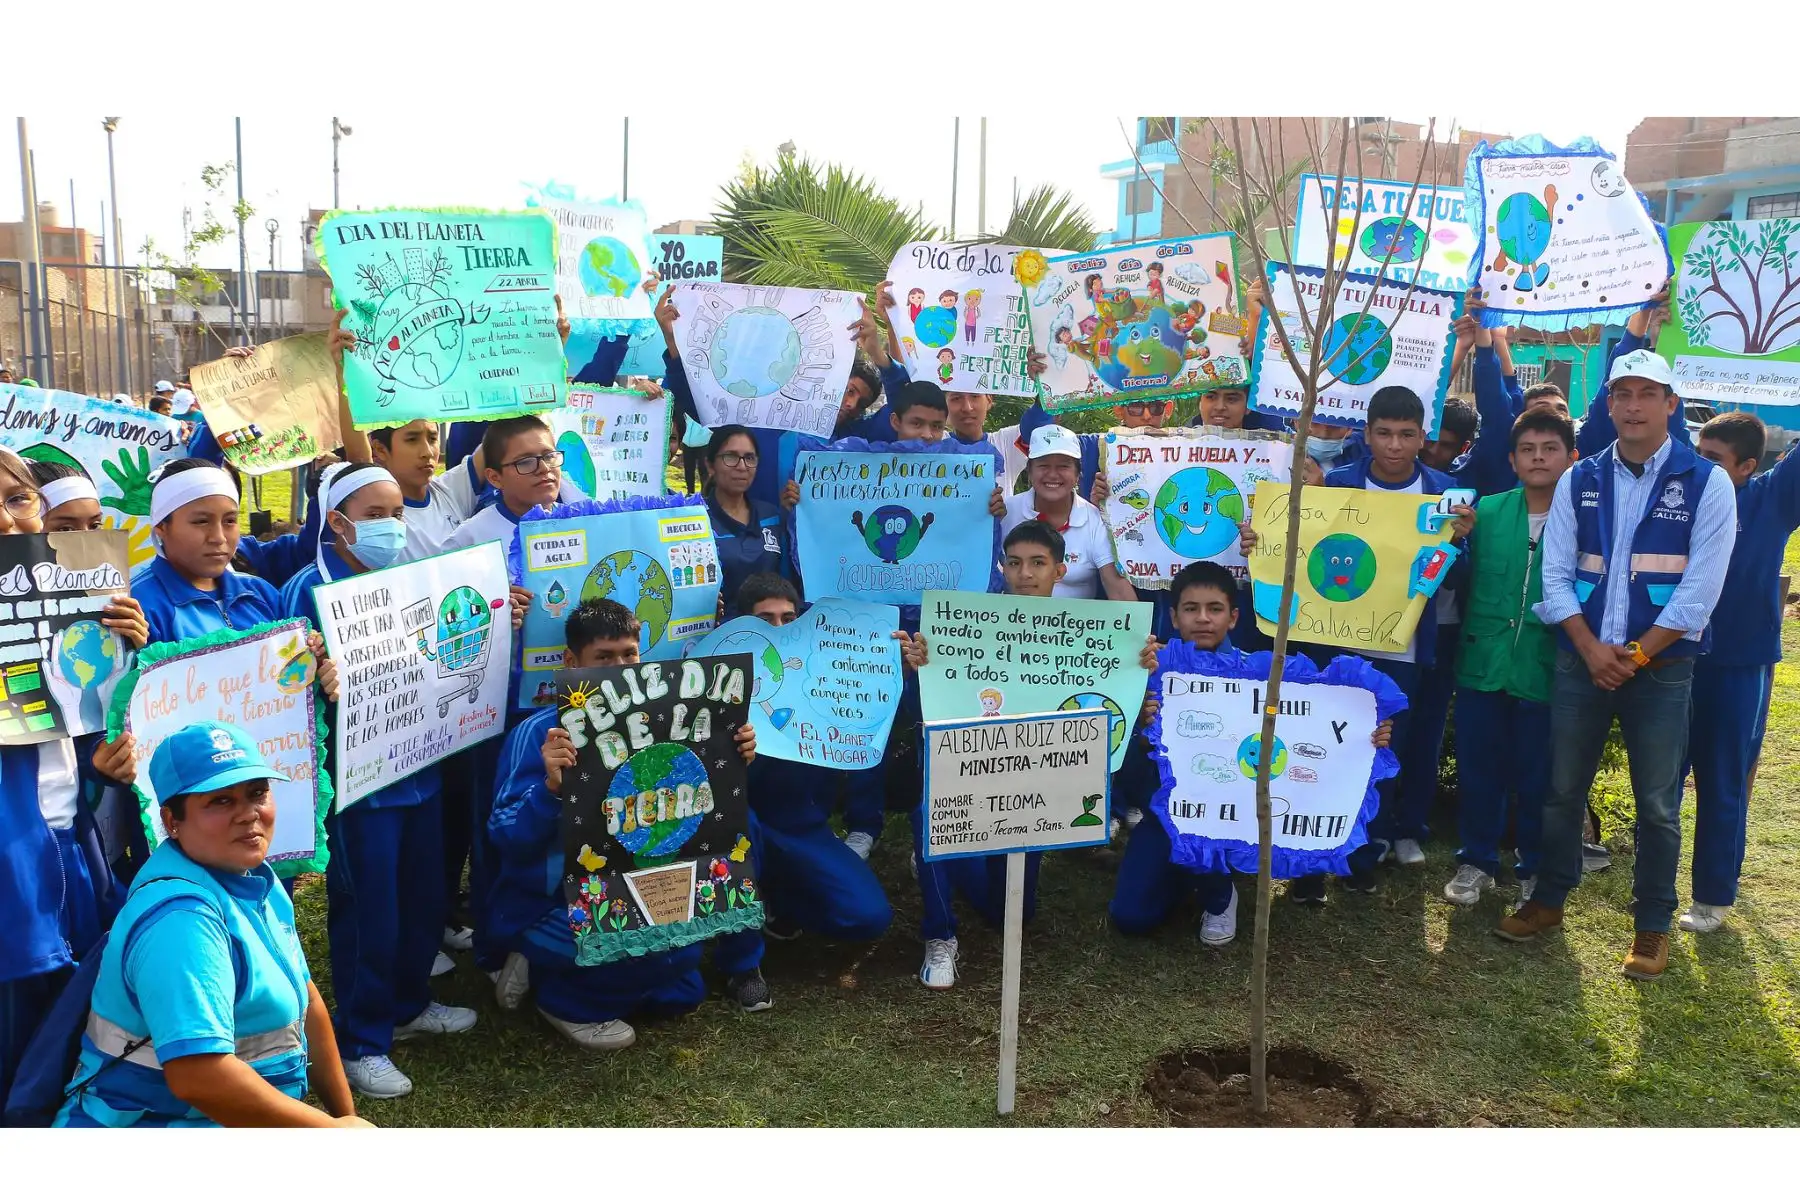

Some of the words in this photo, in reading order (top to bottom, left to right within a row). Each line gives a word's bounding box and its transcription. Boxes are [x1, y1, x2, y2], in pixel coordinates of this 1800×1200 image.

[1382, 191, 1412, 215] TU
[336, 224, 376, 245] DIA
[378, 222, 413, 240] DEL
[418, 222, 485, 241] PLANETA
[456, 245, 532, 271] TIERRA
[661, 240, 685, 262] YO
[912, 245, 952, 269] Día
[956, 247, 975, 272] de
[977, 248, 1004, 276] La
[1156, 247, 1174, 258] de
[1177, 244, 1193, 255] la
[658, 260, 718, 281] HOGAR
[498, 278, 513, 287] 22
[515, 277, 540, 286] ABRIL
[742, 285, 785, 309] TU
[1343, 287, 1366, 304] TU
[1372, 292, 1442, 316] HUELLA
[401, 330, 414, 342] AL
[412, 304, 454, 331] PLANETA
[378, 351, 391, 368] YO
[976, 374, 989, 389] A
[991, 374, 1009, 390] LA
[1734, 372, 1749, 380] nos
[1273, 388, 1283, 399] Y
[1328, 397, 1344, 409] EL
[64, 414, 83, 441] y
[85, 417, 180, 450] amemos
[1116, 444, 1153, 465] DEJA
[1161, 447, 1181, 462] TU
[1188, 447, 1238, 463] HUELLA
[799, 455, 870, 485] Nuestro
[878, 457, 946, 486] planeta
[834, 483, 899, 500] nuestras
[1111, 473, 1141, 495] AHORRA
[1135, 511, 1149, 524] AGUA
[1652, 512, 1689, 522] CALLAO
[666, 523, 703, 534] RECICLA
[533, 539, 567, 551] CUIDA
[568, 538, 581, 548] EL
[544, 552, 572, 564] AGUA
[1126, 559, 1161, 576] SALVA
[36, 565, 125, 591] Planeta
[331, 600, 349, 621] EL
[352, 587, 392, 613] PLANETA
[934, 601, 1000, 624] Hemos
[1007, 608, 1027, 625] de
[1113, 614, 1131, 632] el
[337, 620, 372, 645] EXISTE
[374, 613, 396, 636] PARA
[675, 621, 711, 636] AHORRA
[868, 631, 880, 642] ya
[931, 624, 982, 640] medio
[995, 630, 1074, 648] ambiente
[1085, 634, 1114, 651] así
[819, 640, 865, 653] paremos
[870, 641, 888, 654] con
[936, 643, 985, 661] como
[1020, 653, 1050, 668] nos
[347, 656, 408, 690] NECESIDADES
[816, 676, 828, 686] yo
[945, 668, 957, 680] a
[964, 665, 1009, 682] todos
[137, 686, 180, 722] Todo
[185, 664, 208, 705] lo
[217, 669, 252, 700] que
[347, 686, 364, 708] LOS
[368, 674, 398, 701] SERES
[810, 688, 850, 704] aunque
[856, 690, 872, 703] no
[878, 690, 890, 703] lo
[1165, 677, 1214, 697] DEJA
[1223, 682, 1241, 694] TU
[241, 693, 296, 722] tierra
[560, 661, 669, 749] FELIZ
[679, 660, 745, 704] DIA
[1253, 688, 1311, 716] HELLA
[346, 711, 361, 730] NO
[366, 703, 379, 721] LA
[346, 728, 359, 751] DE
[361, 719, 378, 743] LOS
[385, 704, 426, 734] HOMBRES
[423, 726, 436, 746] NO
[437, 723, 450, 738] AL
[595, 710, 654, 771] DE
[670, 703, 712, 742] LA
[937, 726, 1009, 755] ALBINA
[1015, 722, 1055, 749] RUIZ
[1062, 718, 1099, 744] RIOS
[1331, 720, 1348, 744] Y
[799, 742, 814, 759] Mi
[822, 743, 868, 764] HOGAR
[959, 749, 1089, 777] MINISTRA-MINAM
[601, 781, 715, 836] TIERRA
[933, 794, 974, 809] NOMBRE
[986, 793, 1046, 813] TECOMA
[1219, 804, 1239, 821] EL
[932, 808, 969, 821] COMUN
[932, 821, 973, 834] NOMBRE
